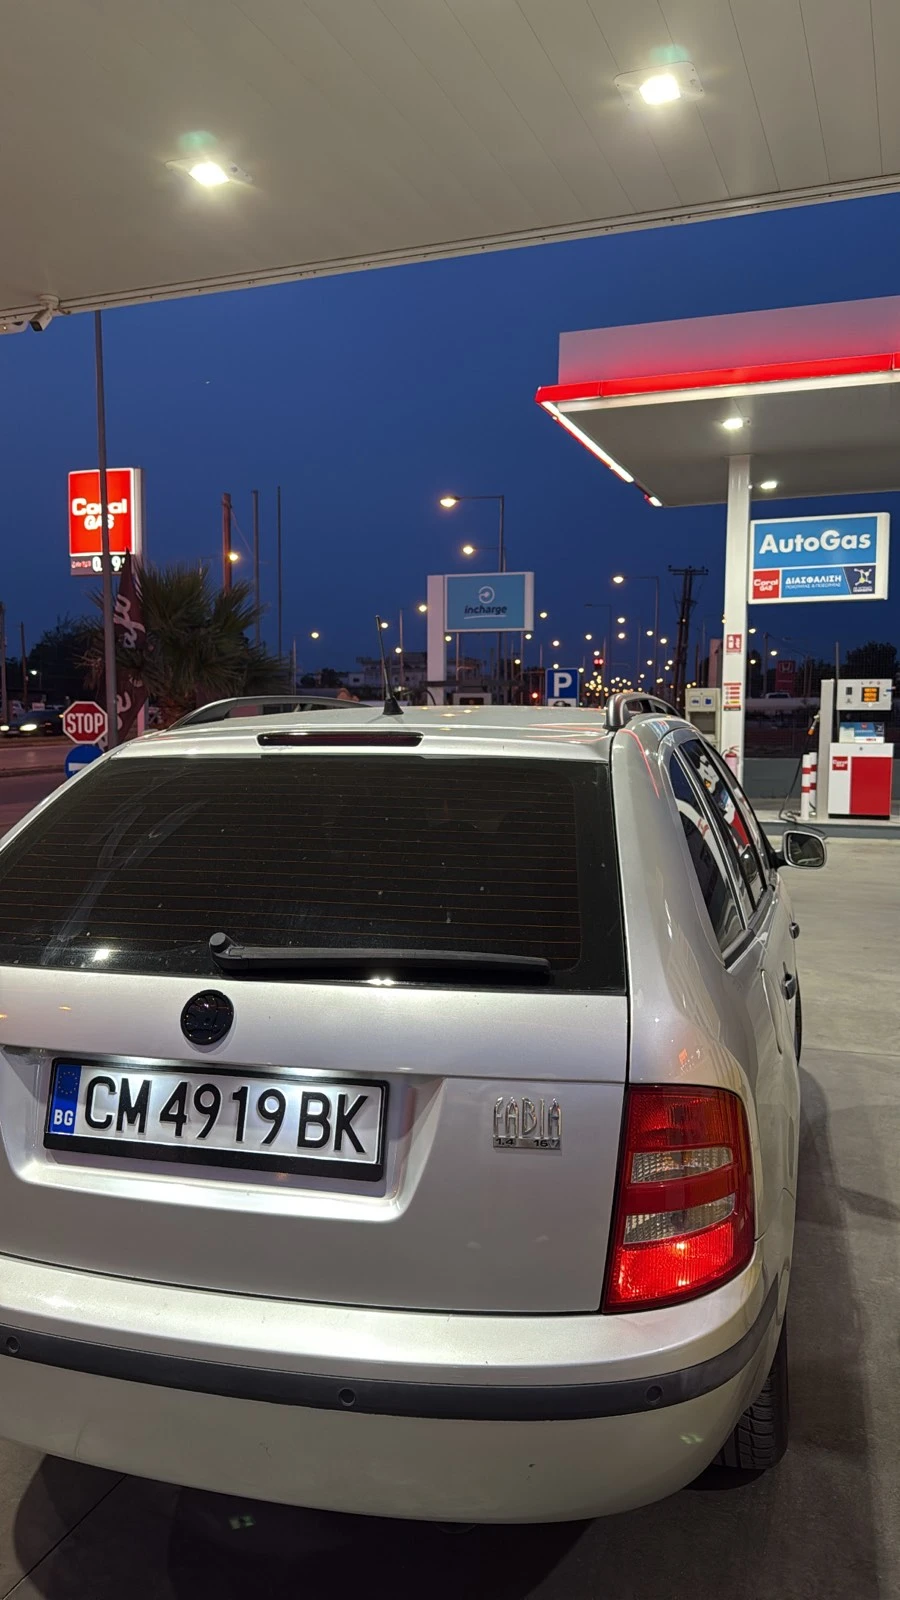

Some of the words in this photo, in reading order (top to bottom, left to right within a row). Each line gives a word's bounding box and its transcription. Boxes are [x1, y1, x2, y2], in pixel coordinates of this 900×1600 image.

[759, 530, 871, 554] AutoGas
[753, 578, 779, 587] Coral
[785, 575, 842, 585] ΔΙΑΣΦΑΛΙΣΗ
[464, 605, 508, 616] incharge
[553, 672, 573, 697] P
[66, 712, 104, 734] STOP
[53, 1109, 74, 1126] BG
[84, 1076, 150, 1134] CM
[158, 1081, 286, 1145] 4919
[297, 1091, 369, 1153] BK
[493, 1096, 562, 1136] FABIA
